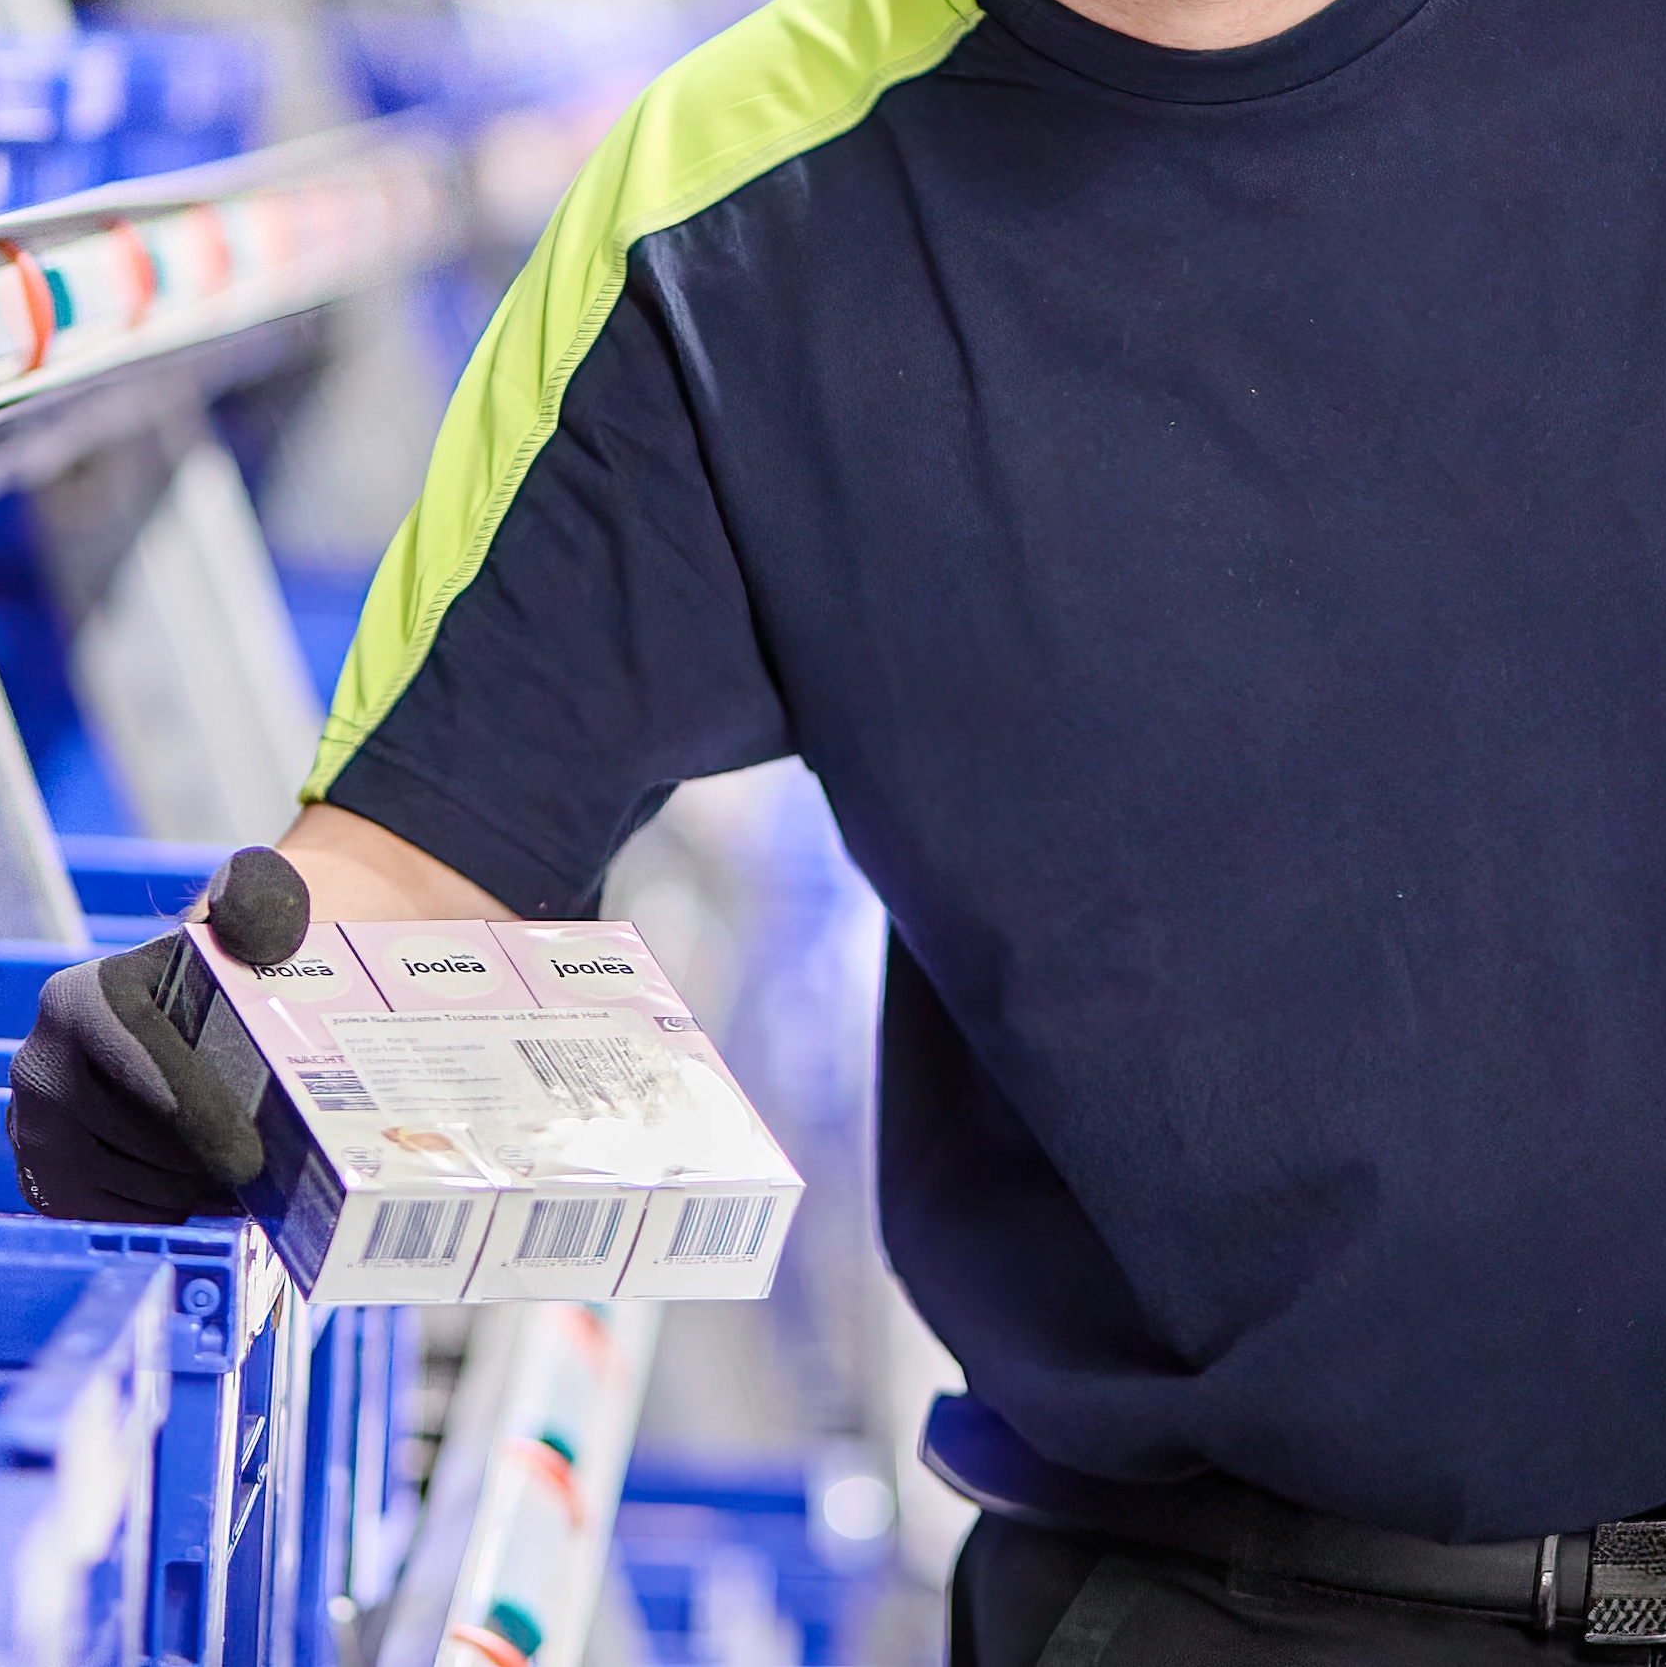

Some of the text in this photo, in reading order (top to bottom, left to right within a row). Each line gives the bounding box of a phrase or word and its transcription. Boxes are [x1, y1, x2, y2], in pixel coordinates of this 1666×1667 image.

[252, 963, 335, 981] joolea
[401, 958, 487, 977] joolea
[550, 959, 635, 978] joolea
